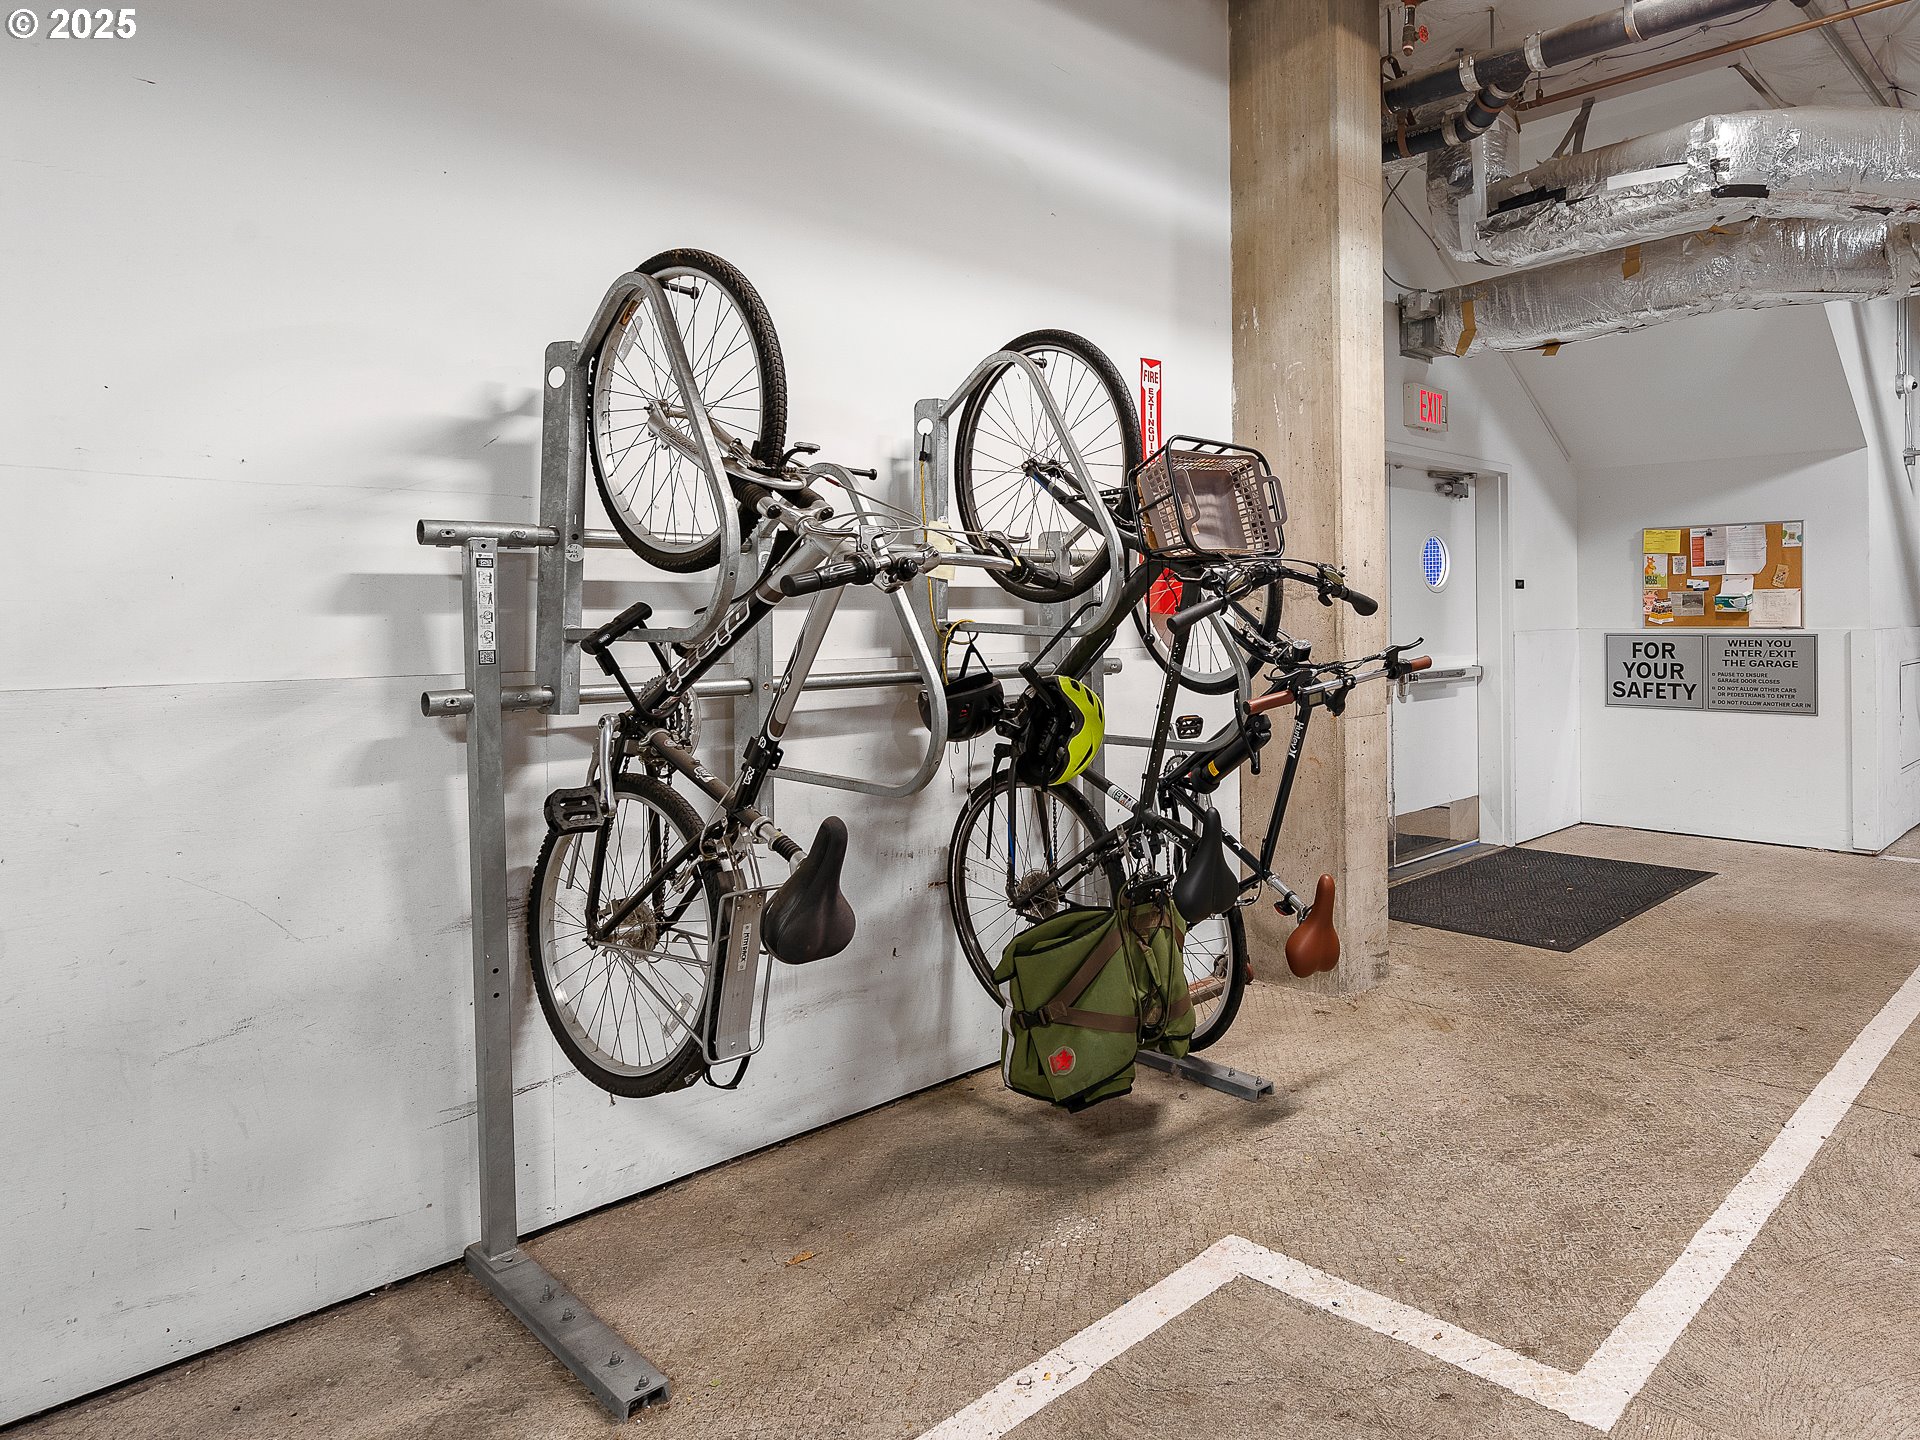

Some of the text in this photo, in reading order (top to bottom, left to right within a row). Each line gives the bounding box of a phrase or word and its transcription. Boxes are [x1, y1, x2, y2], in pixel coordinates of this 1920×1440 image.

[1143, 370, 1159, 384] FIRE
[1420, 389, 1443, 425] EXIT
[1632, 642, 1676, 659] FOR
[1766, 640, 1791, 648] YOU
[1724, 649, 1796, 658] ENTER/EXIT
[1622, 662, 1684, 679] YOUR
[1722, 659, 1799, 668] THE GARAGE
[1612, 681, 1697, 700] SAFETY
[1291, 720, 1304, 749] Hurley
